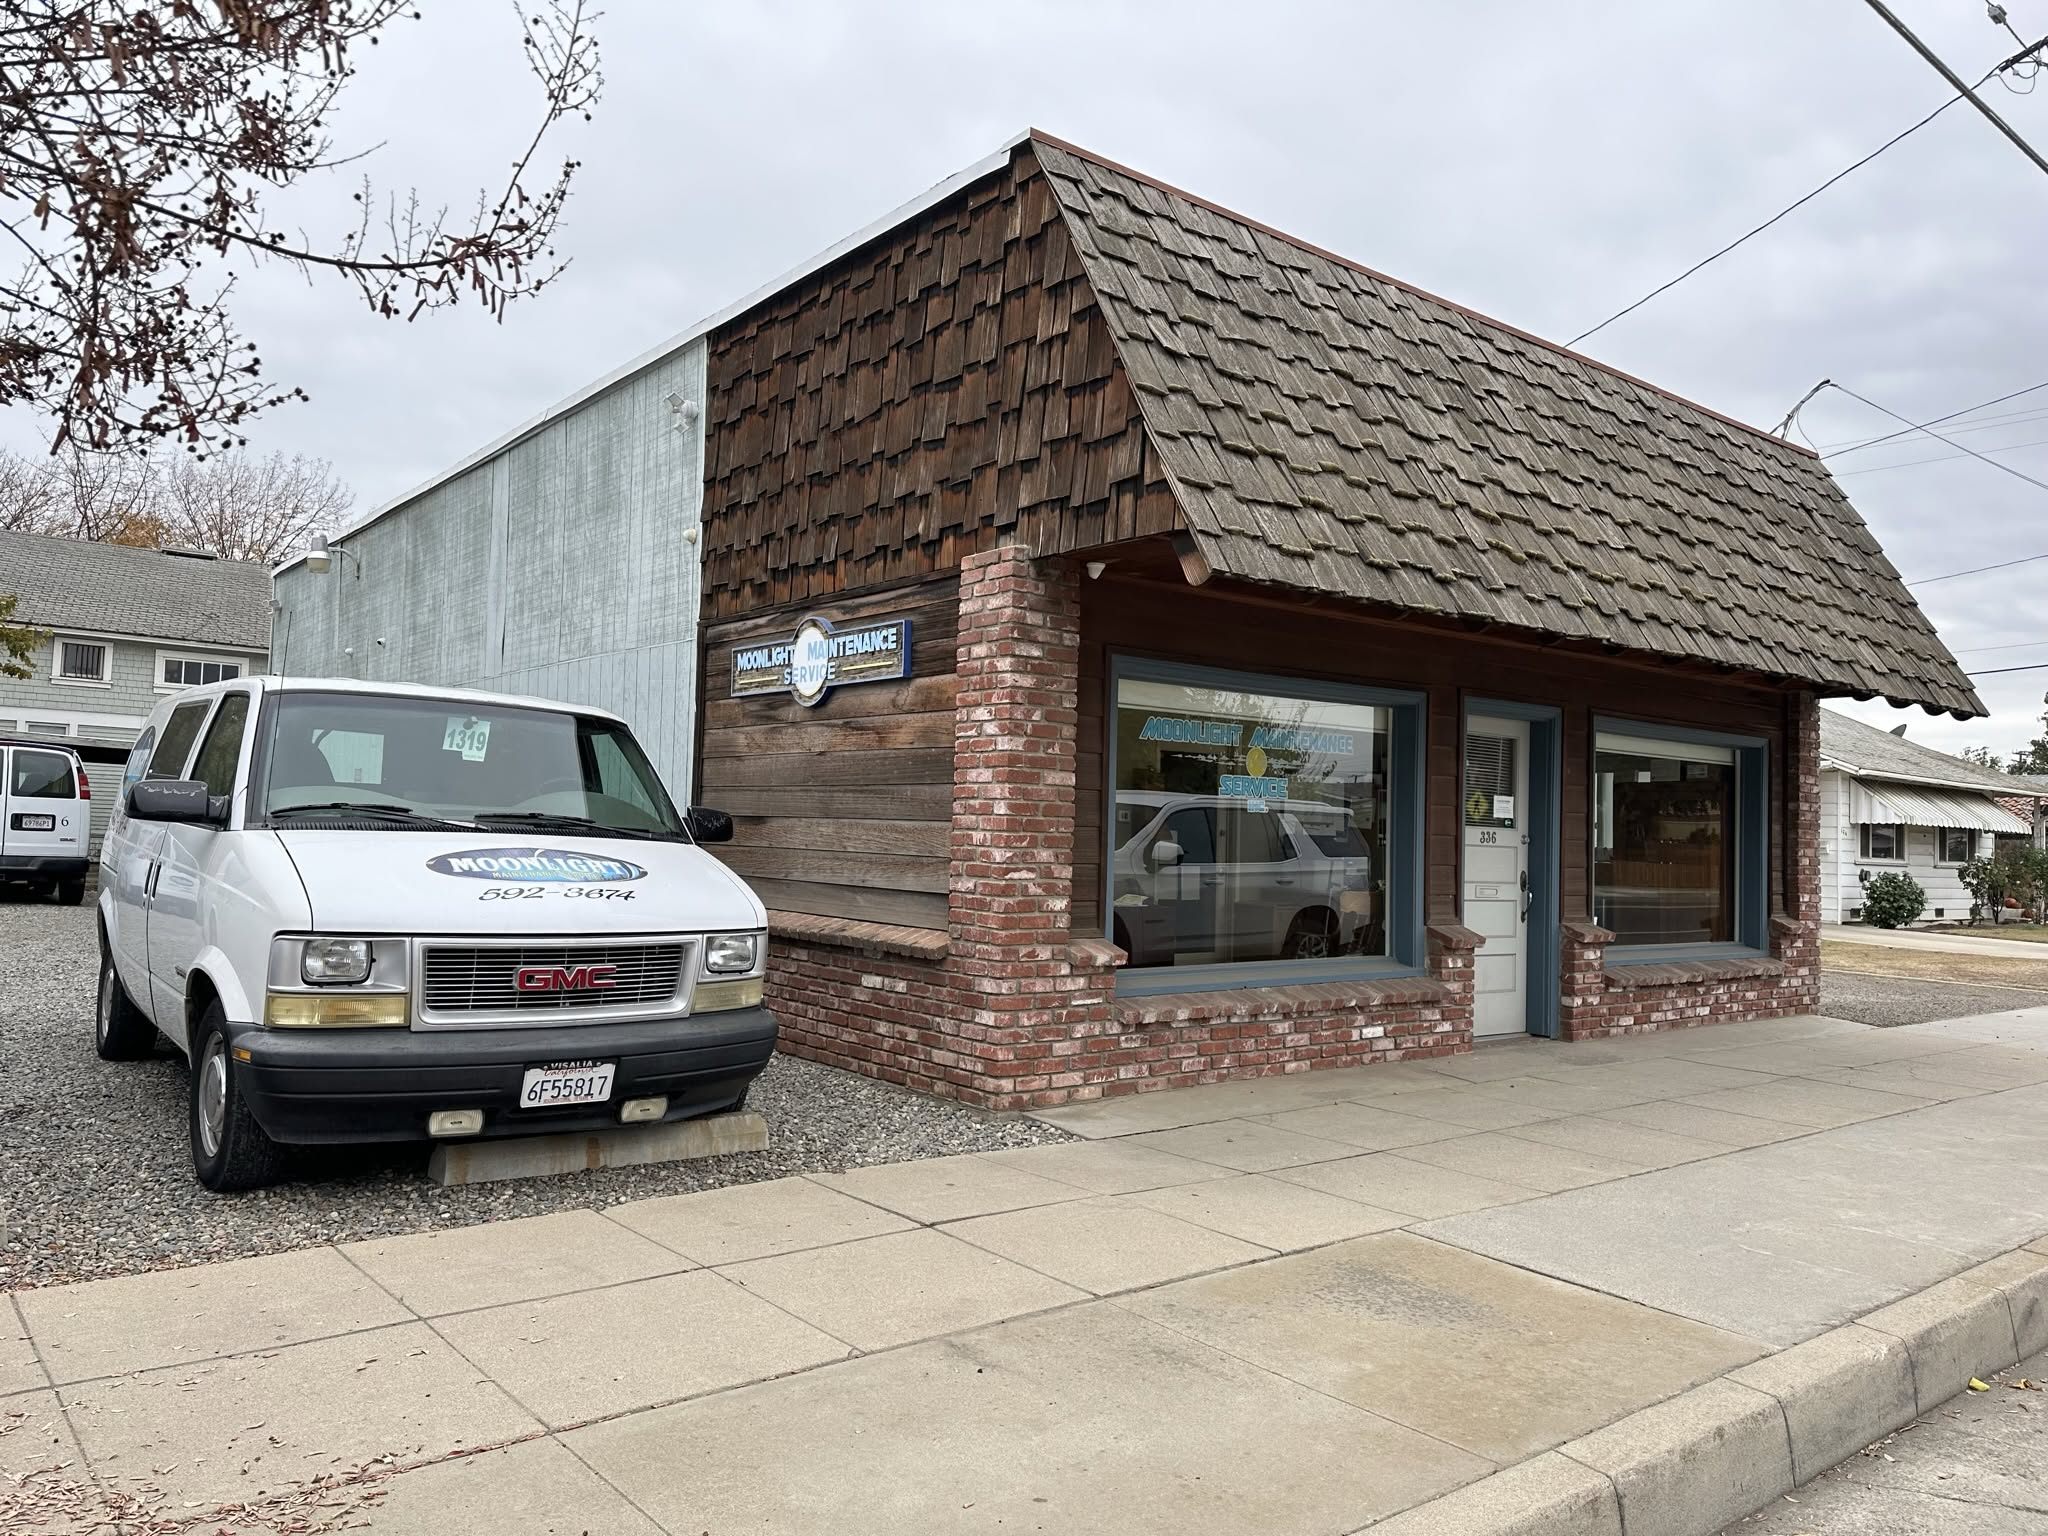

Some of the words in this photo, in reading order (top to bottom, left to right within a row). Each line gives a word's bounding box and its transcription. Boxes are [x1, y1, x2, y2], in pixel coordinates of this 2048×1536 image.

[737, 645, 796, 671] MOONLIGHT
[808, 628, 897, 661] MAINTENANCE
[784, 661, 836, 685] SERVICE
[447, 728, 487, 752] 1319
[1139, 716, 1243, 747] MOONLIGHT
[1248, 726, 1354, 755] MAINTENANCE
[1219, 775, 1288, 799] SERVICE
[61, 815, 70, 827] 6
[1480, 831, 1497, 844] 336
[447, 856, 625, 876] MOONLIGHT
[478, 886, 636, 901] 592-3674
[517, 966, 617, 991] GMC
[550, 1060, 593, 1070] VISALIA
[527, 1076, 608, 1103] 6F55817
